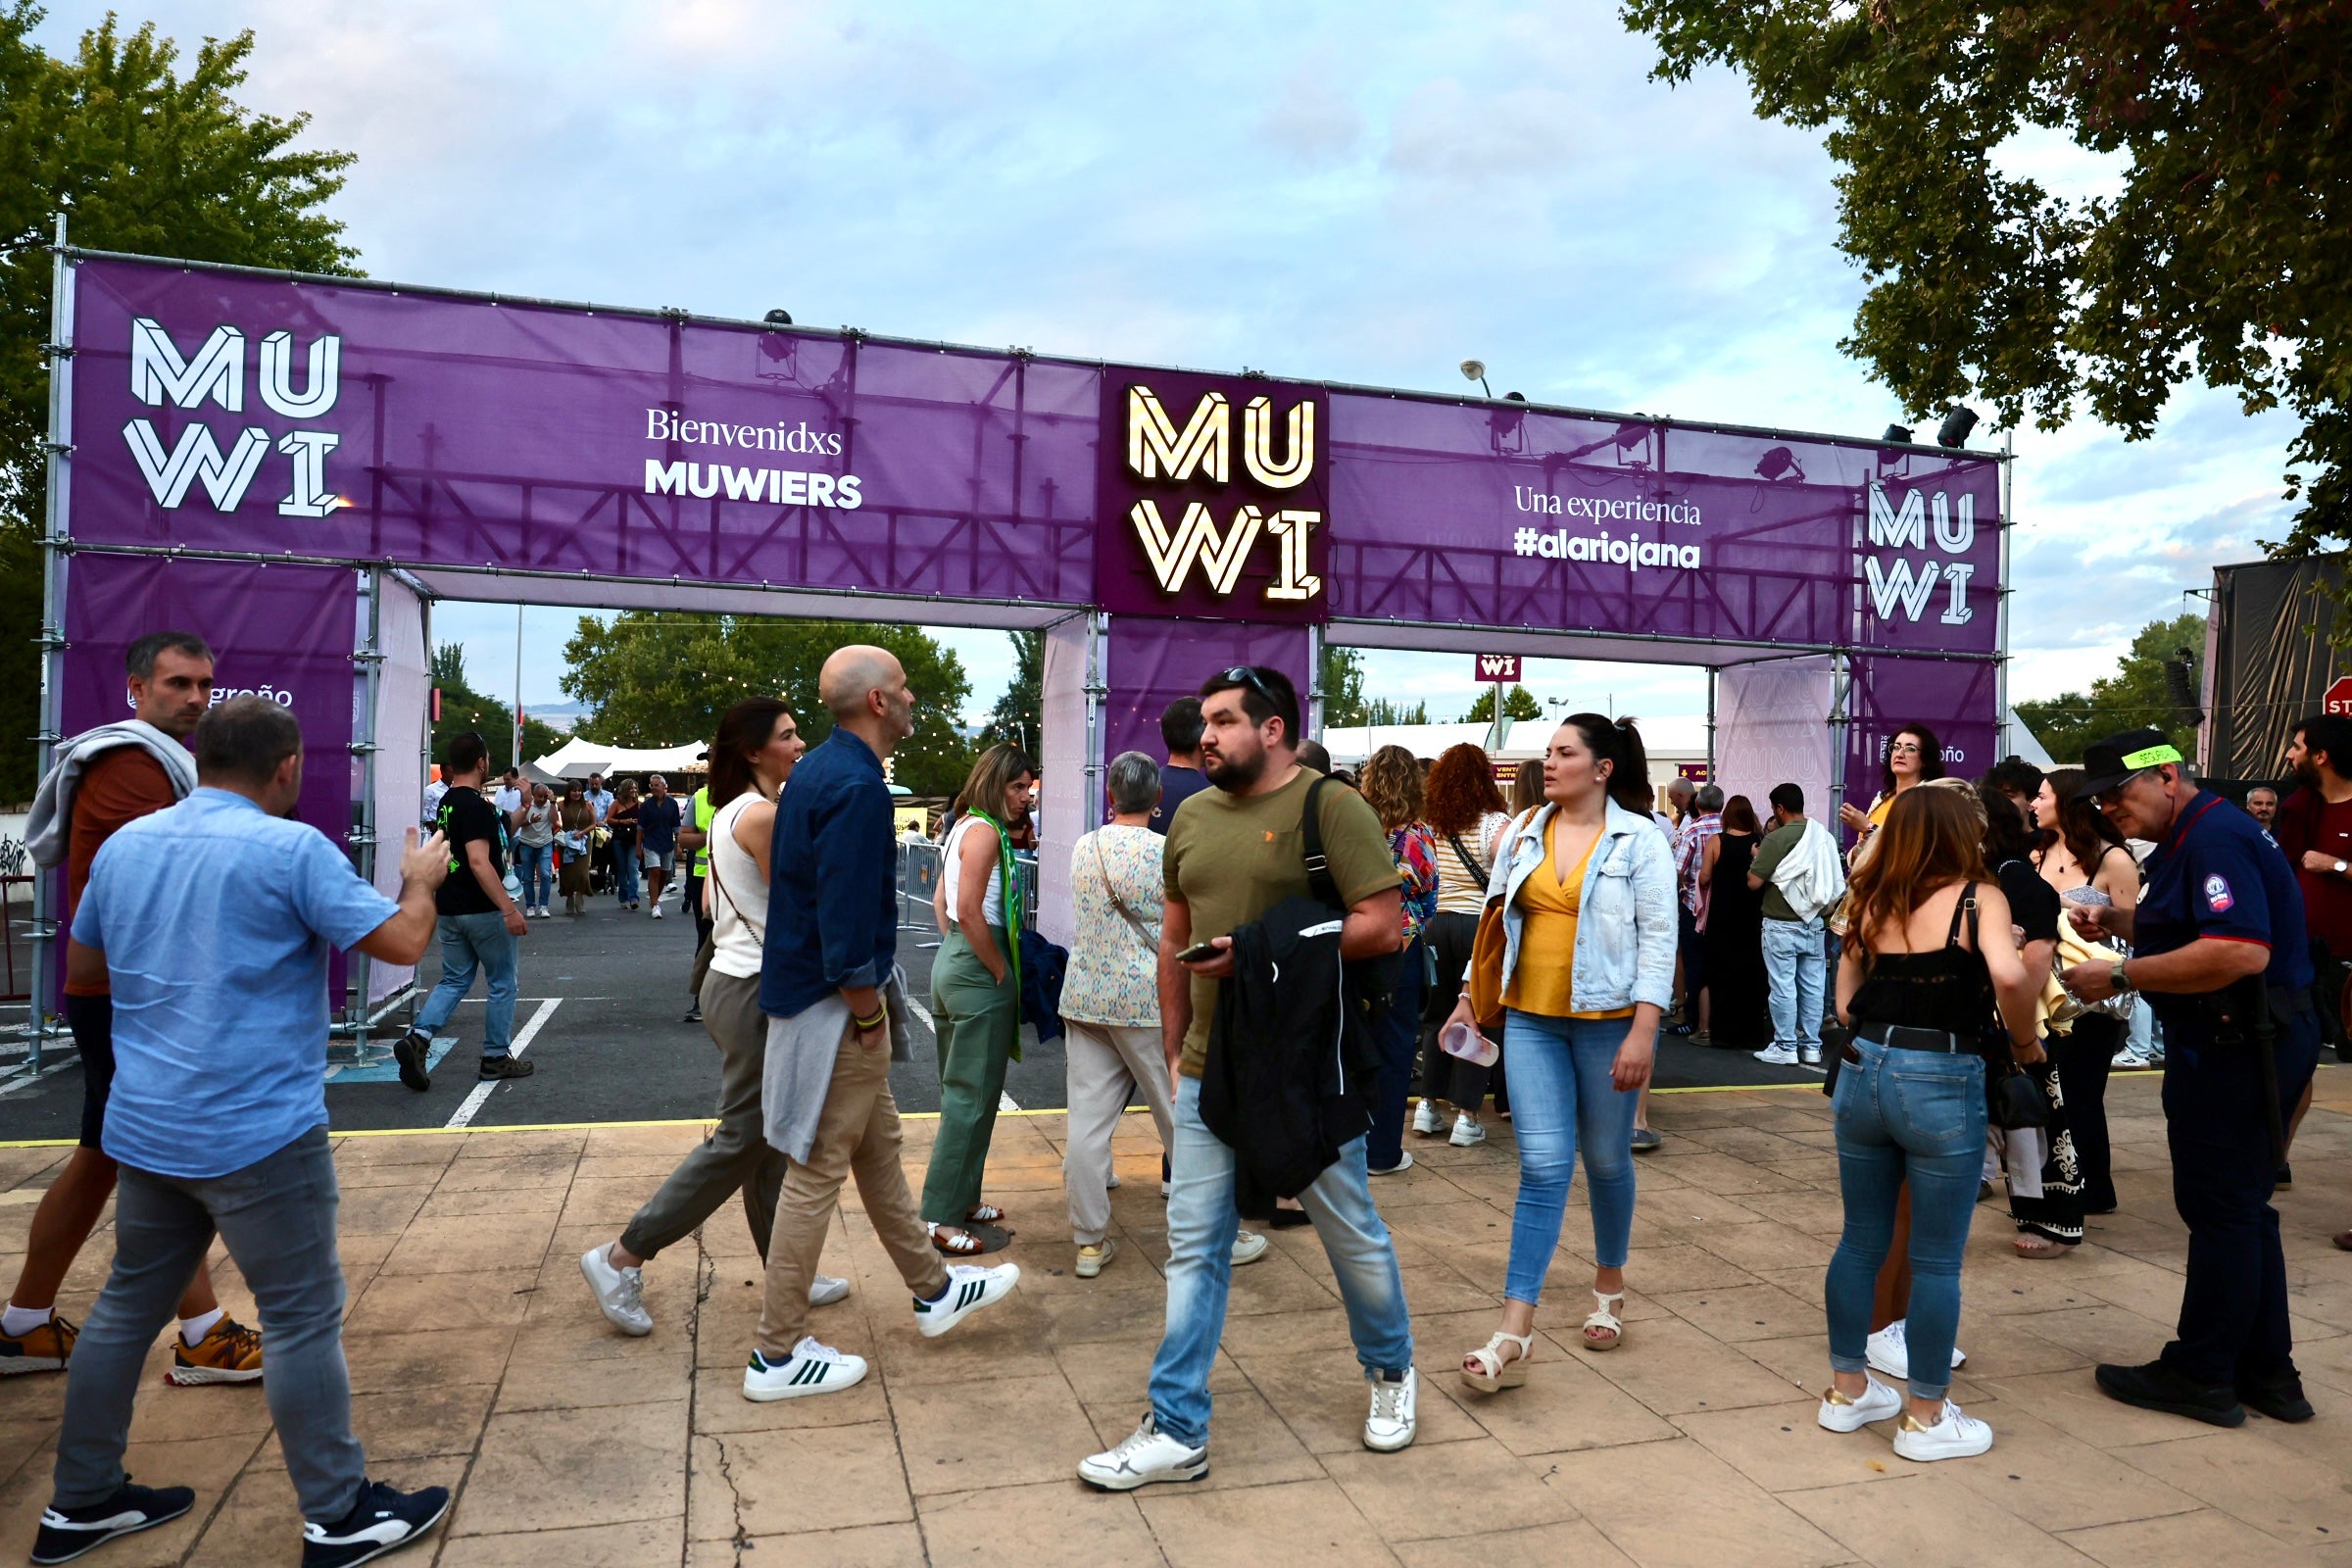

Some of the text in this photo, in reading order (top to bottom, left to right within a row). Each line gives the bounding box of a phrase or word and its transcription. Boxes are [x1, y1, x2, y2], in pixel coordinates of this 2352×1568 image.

[131, 318, 340, 418] MU
[645, 408, 843, 458] Bienvenidxs
[1128, 385, 1316, 489] MU
[122, 417, 340, 517] WI
[644, 459, 862, 510] MUWIERS
[1513, 485, 1702, 526] Una experiencia
[1868, 482, 1976, 555] MU
[1129, 498, 1322, 601] WI
[1513, 526, 1700, 572] #alariojana
[1863, 554, 1976, 627] WI
[1481, 659, 1515, 676] WI
[2328, 700, 2352, 713] ST
